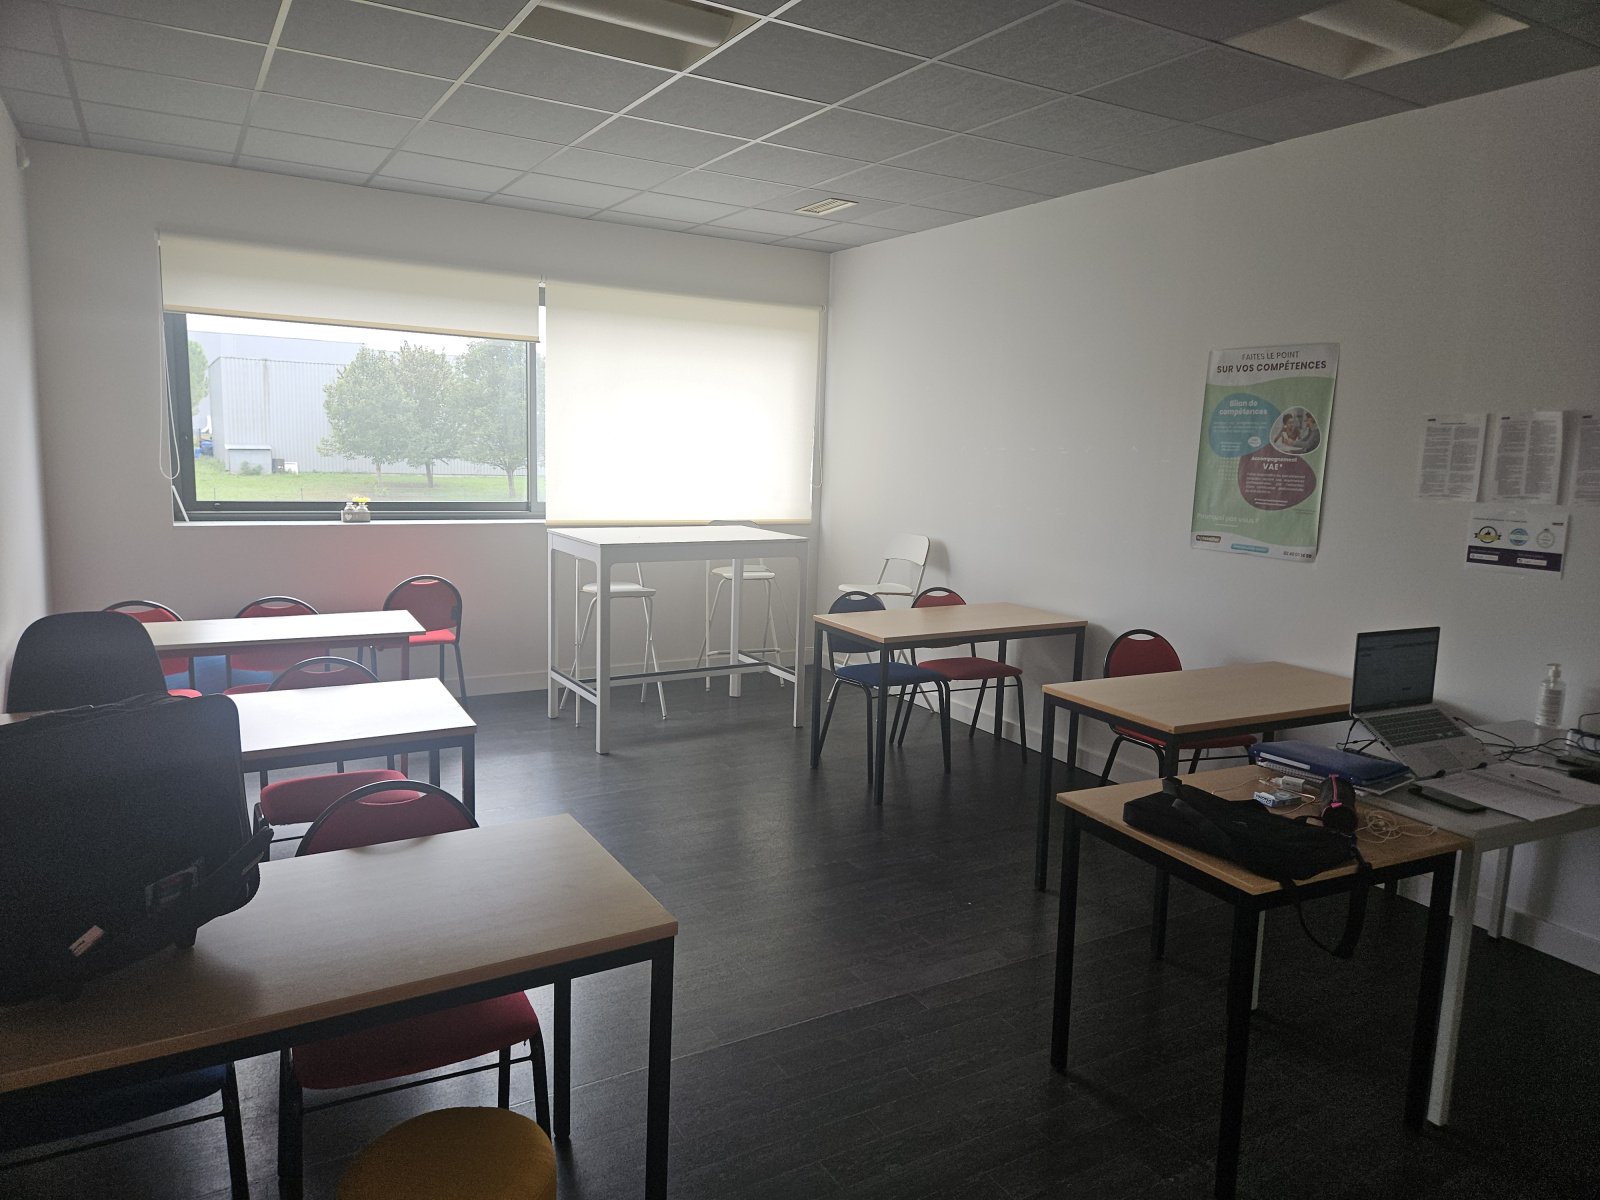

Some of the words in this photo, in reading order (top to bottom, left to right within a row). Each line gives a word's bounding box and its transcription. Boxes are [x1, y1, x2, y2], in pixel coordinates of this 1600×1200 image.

[1242, 352, 1265, 360] FAITES
[1266, 352, 1274, 360] LE
[1276, 351, 1300, 359] POINT
[1216, 364, 1233, 373] SUR
[1236, 363, 1254, 373] VOS
[1257, 360, 1327, 372] COMPÉTENCES
[1219, 408, 1268, 417] compétences
